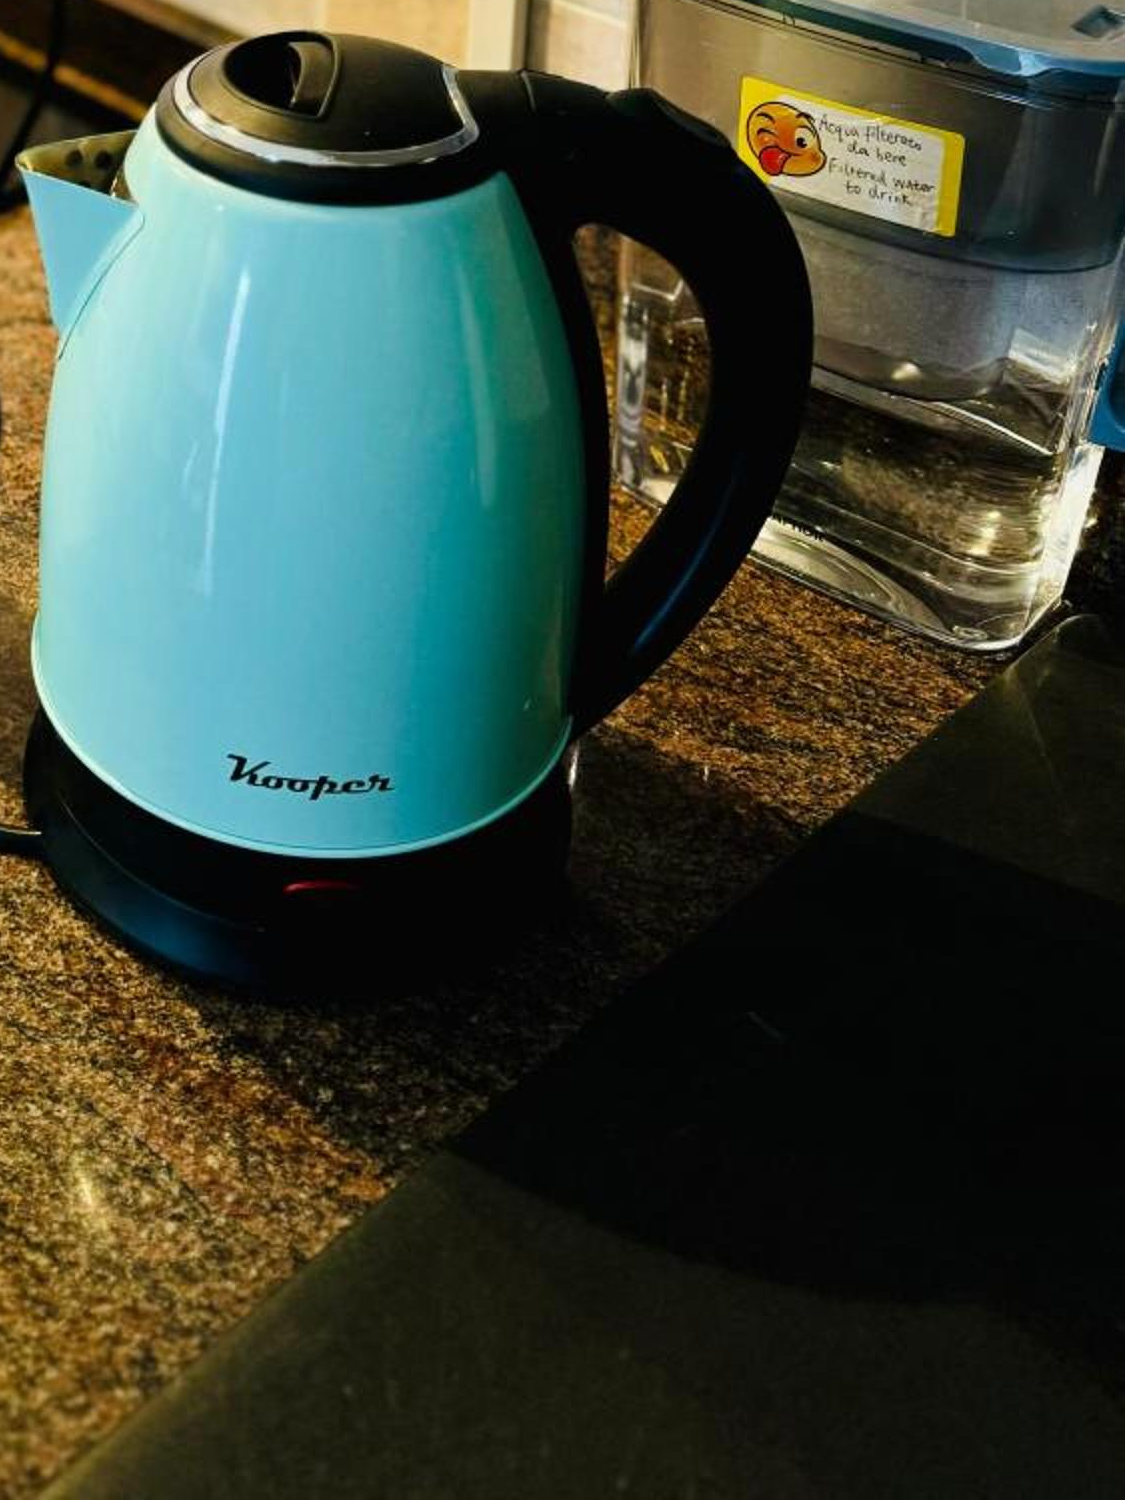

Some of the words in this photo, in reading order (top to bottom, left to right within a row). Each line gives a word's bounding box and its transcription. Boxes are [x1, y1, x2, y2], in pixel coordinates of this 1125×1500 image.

[819, 113, 860, 142] Acqua
[847, 140, 870, 156] da
[828, 157, 887, 186] Filtered
[893, 177, 936, 192] water
[846, 181, 861, 194] to
[868, 185, 914, 205] drink
[226, 753, 395, 801] Kooper
